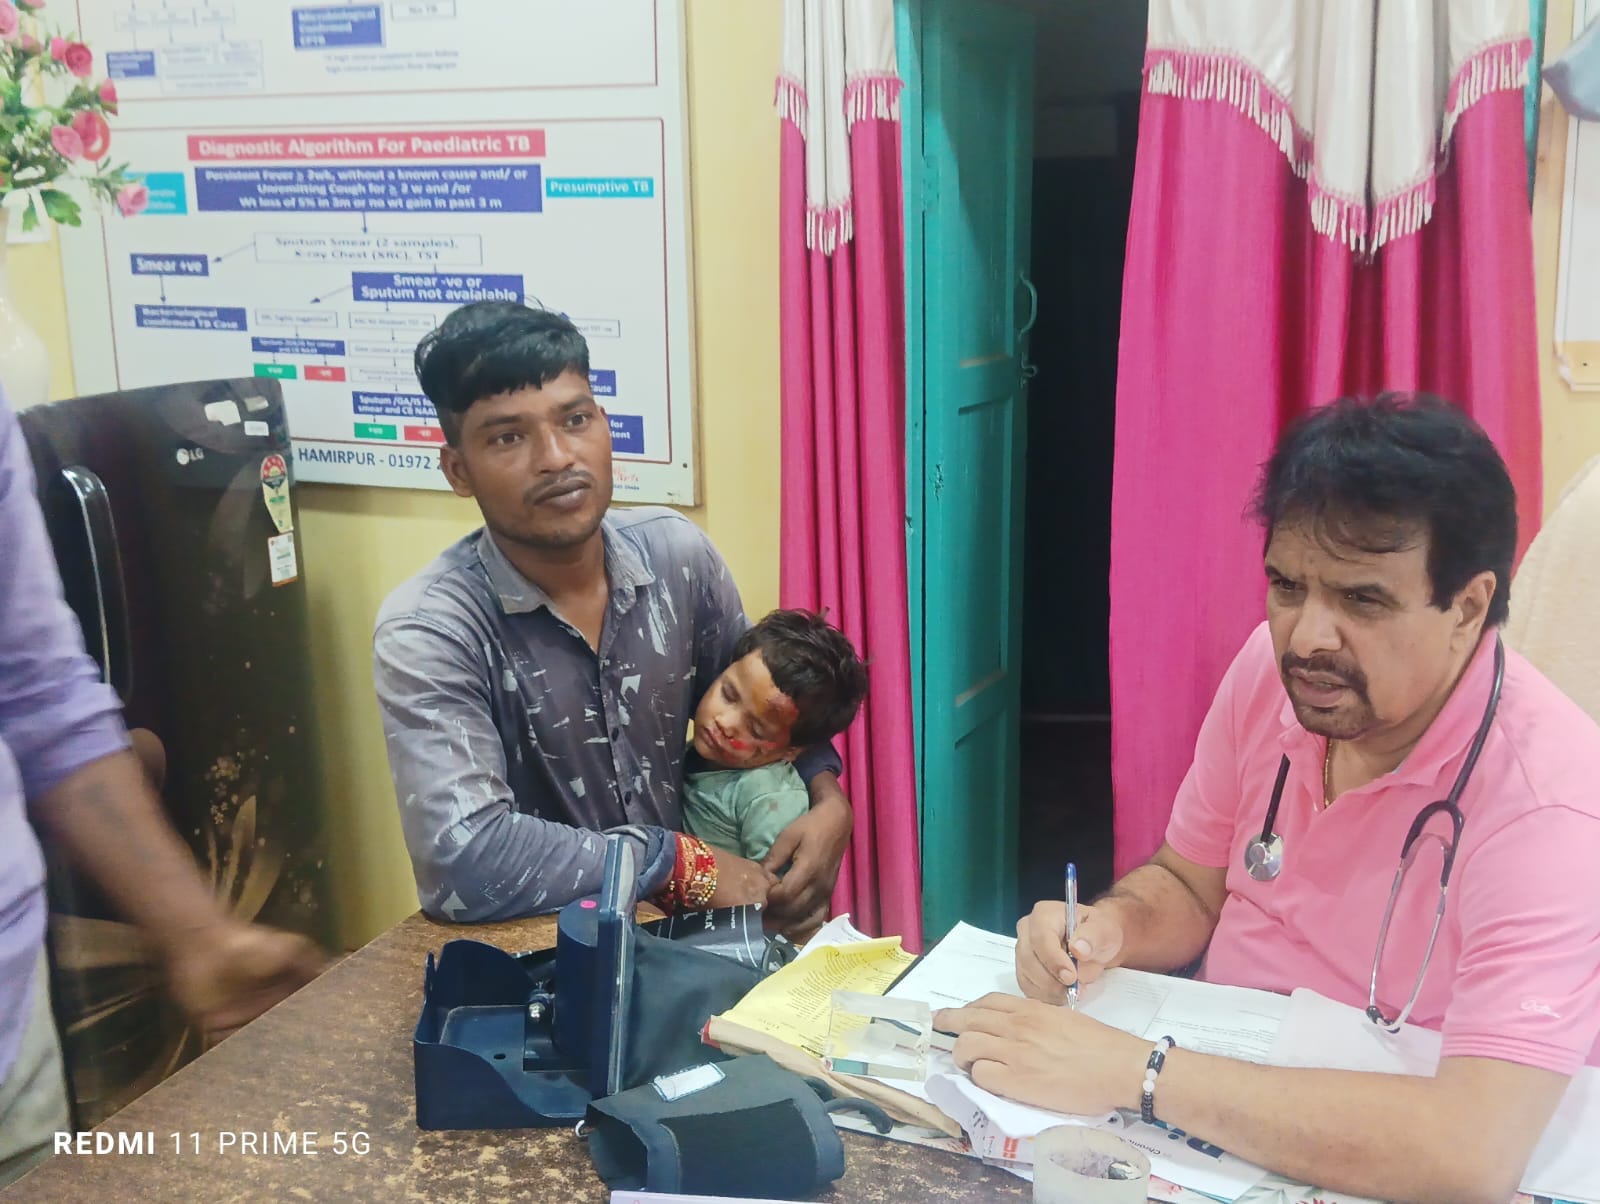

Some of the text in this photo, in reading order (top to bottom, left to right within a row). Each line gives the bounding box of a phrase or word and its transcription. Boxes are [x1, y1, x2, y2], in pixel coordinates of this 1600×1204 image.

[200, 135, 530, 159] Diagnostic Algorithm For Paediatric TB
[338, 169, 385, 182] without
[388, 171, 395, 181] a
[397, 168, 440, 181] known
[442, 169, 477, 181] cause
[480, 168, 511, 181] and/
[513, 170, 528, 180] or
[329, 183, 366, 197] Cough
[368, 183, 386, 195] for
[425, 183, 449, 195] and
[550, 180, 649, 195] Presumptive TB
[283, 197, 296, 208] of
[449, 196, 475, 210] past
[329, 237, 371, 247] Smear
[331, 249, 368, 259] Chest
[136, 257, 203, 274] Smear +ve
[393, 273, 483, 289] Smear -ve or
[361, 285, 415, 301] Sputum
[417, 287, 442, 300] not
[359, 394, 392, 406] Sputum
[357, 404, 383, 413] smear
[384, 405, 401, 414] and
[610, 419, 624, 429] for
[189, 447, 205, 462] LG
[298, 447, 376, 466] HAMIRPUR
[388, 453, 432, 470] 01972
